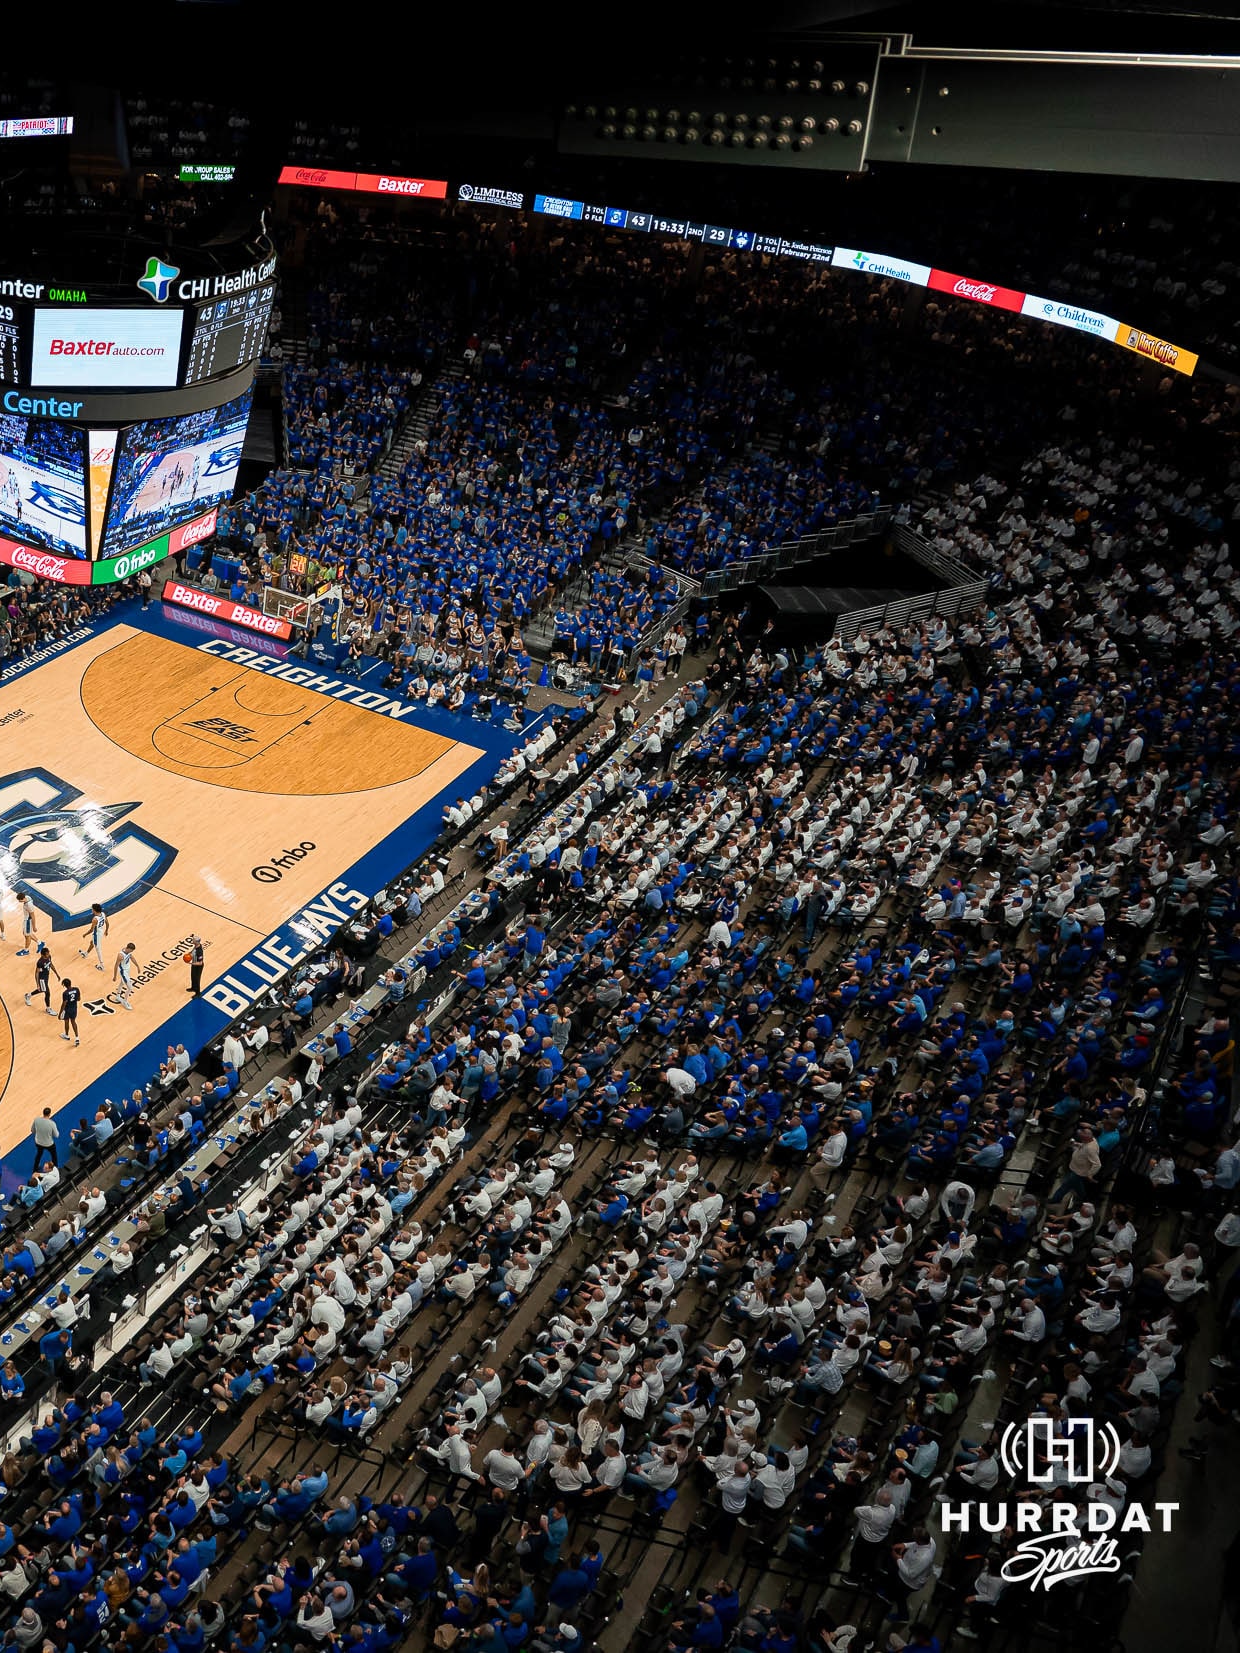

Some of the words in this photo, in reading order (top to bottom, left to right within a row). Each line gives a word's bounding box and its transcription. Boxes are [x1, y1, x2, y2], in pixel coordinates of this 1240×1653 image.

[22, 120, 48, 130] PATRIOT
[378, 178, 424, 194] Baxter
[474, 186, 524, 202] LIMITLESS
[631, 215, 646, 227] 43
[654, 220, 684, 234] 19:33
[688, 228, 703, 236] 2ND
[710, 229, 725, 241] 29
[763, 245, 776, 253] FLS
[765, 238, 778, 246] TOL
[781, 247, 811, 260] February
[812, 253, 830, 262] 22nd
[868, 263, 885, 273] CHI
[885, 266, 911, 280] Health
[179, 278, 210, 300] CHI
[214, 267, 257, 295] Health
[49, 288, 87, 302] OMAHA
[260, 286, 273, 301] 29
[200, 307, 213, 322] 43
[1057, 306, 1105, 329] Children's
[6, 326, 16, 335] FLS
[1137, 334, 1156, 353] Host
[1153, 341, 1178, 366] Coffee
[3, 391, 83, 418] Center
[11, 546, 68, 581] Coca-Cola
[131, 549, 156, 571] fnbo
[172, 585, 221, 614] Baxter
[231, 607, 283, 633] Baxter
[197, 639, 416, 718] CREIGHTON
[192, 720, 259, 744] EAST
[271, 841, 317, 870] fnbo
[202, 935, 307, 1019] BLUE
[288, 882, 369, 951] JAYS
[130, 960, 170, 989] Health
[70, 993, 76, 1002] 2
